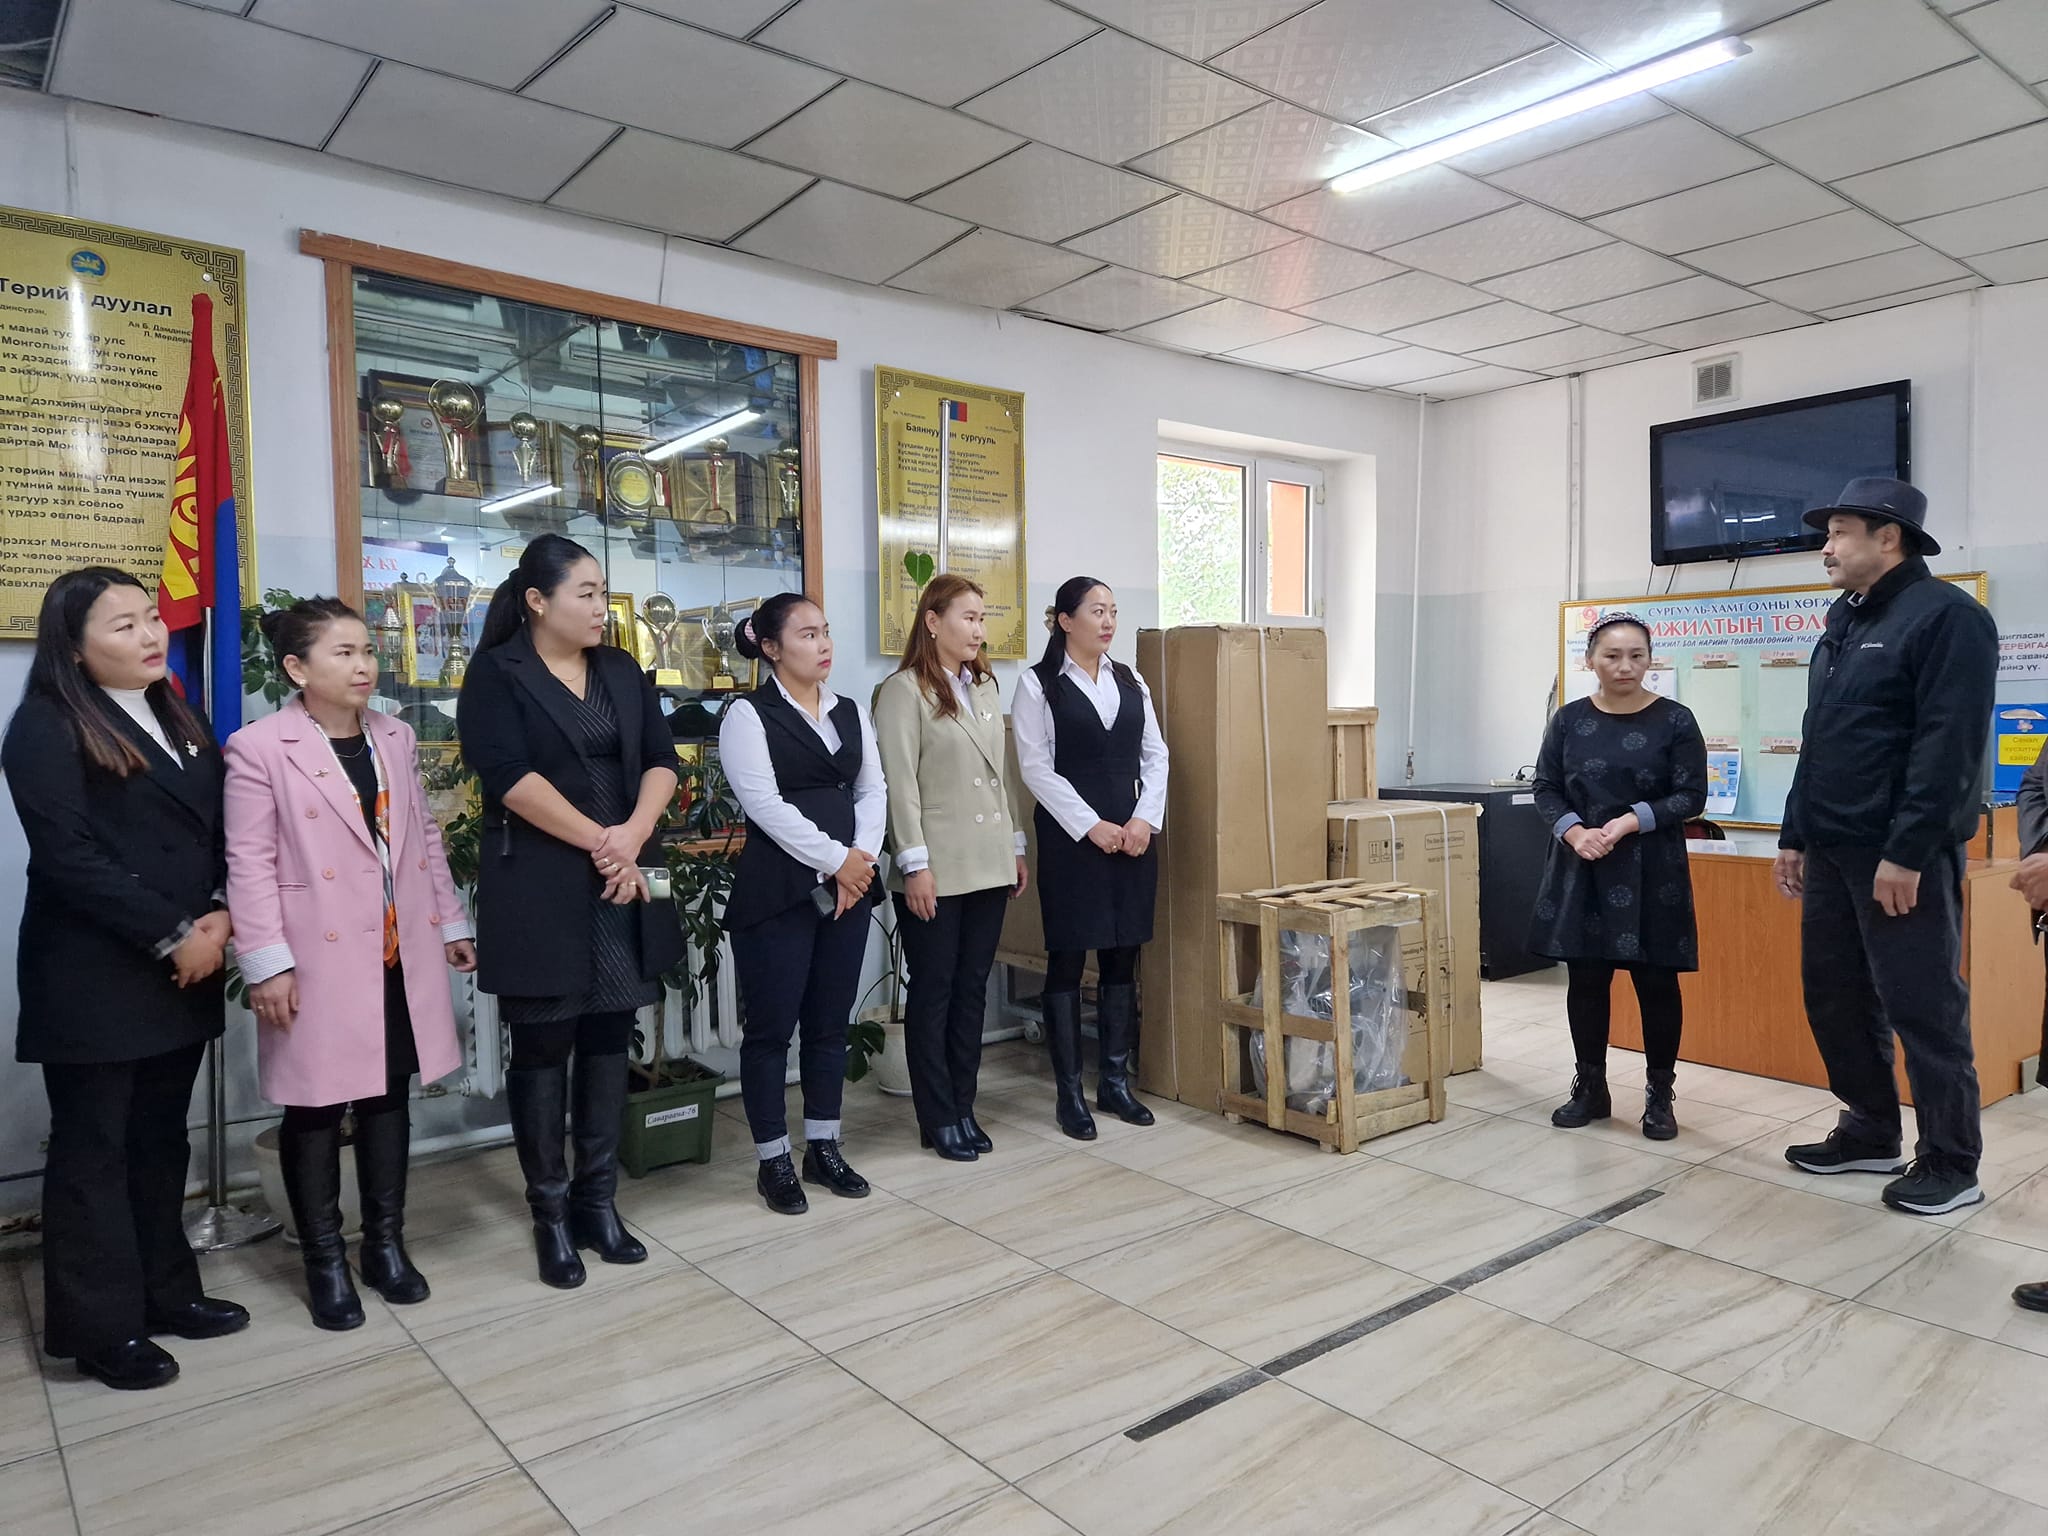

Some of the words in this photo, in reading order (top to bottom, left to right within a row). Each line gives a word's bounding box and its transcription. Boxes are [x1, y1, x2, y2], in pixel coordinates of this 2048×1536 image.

[0, 277, 84, 304] Төрий
[91, 295, 172, 317] дуулал
[0, 304, 47, 316] динсүрэн,
[9, 324, 49, 335] манай
[104, 336, 126, 345] улс
[1, 335, 69, 352] Монголын
[113, 351, 157, 363] голомт
[3, 352, 18, 360] их
[0, 394, 29, 402] амаг
[89, 403, 142, 415] шударга
[145, 410, 179, 420] улста
[0, 408, 45, 419] амтран
[134, 421, 178, 435] бэхжүү
[0, 422, 28, 432] атан
[32, 426, 68, 436] зориг
[112, 432, 177, 447] чадлаараа
[961, 433, 996, 445] сургууль
[0, 436, 45, 447] айртай
[100, 446, 138, 456] орноо
[141, 450, 178, 461] манду
[8, 466, 55, 476] төрийн
[128, 476, 166, 486] ивээж
[6, 480, 53, 490] түмний
[57, 484, 90, 493] минь
[6, 494, 49, 505] язгуур
[53, 498, 75, 506] хэл
[51, 538, 117, 550] Монголын
[120, 542, 163, 553] золтой
[1648, 603, 1744, 617] СУРГУУЛЬ-ХАМТ
[1748, 600, 1790, 612] ОЛНЫ
[1794, 597, 1833, 609] ХӨГЖ
[1647, 614, 1763, 637] МЖИЛТЫН
[1683, 640, 1696, 648] БОЛ
[1699, 637, 1728, 647] НАРИЙН
